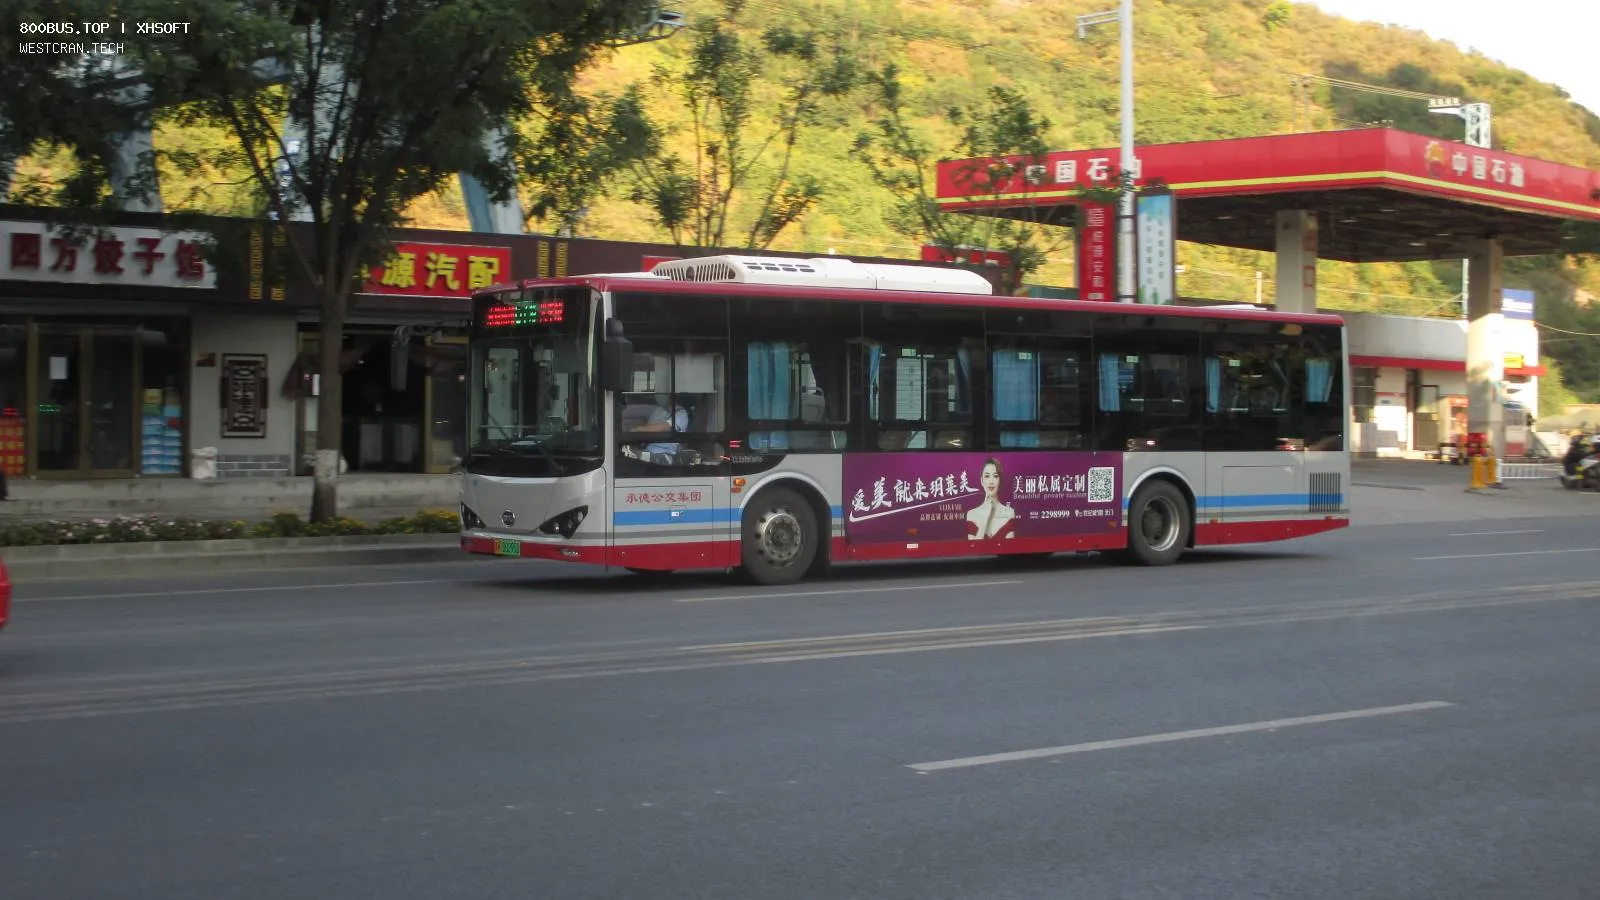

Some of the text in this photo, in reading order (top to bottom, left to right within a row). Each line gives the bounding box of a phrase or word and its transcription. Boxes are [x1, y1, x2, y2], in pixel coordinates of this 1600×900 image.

[354, 251, 499, 290] 源汽配
[625, 491, 702, 504] 承德公交集团
[1041, 510, 1070, 519] 2298999
